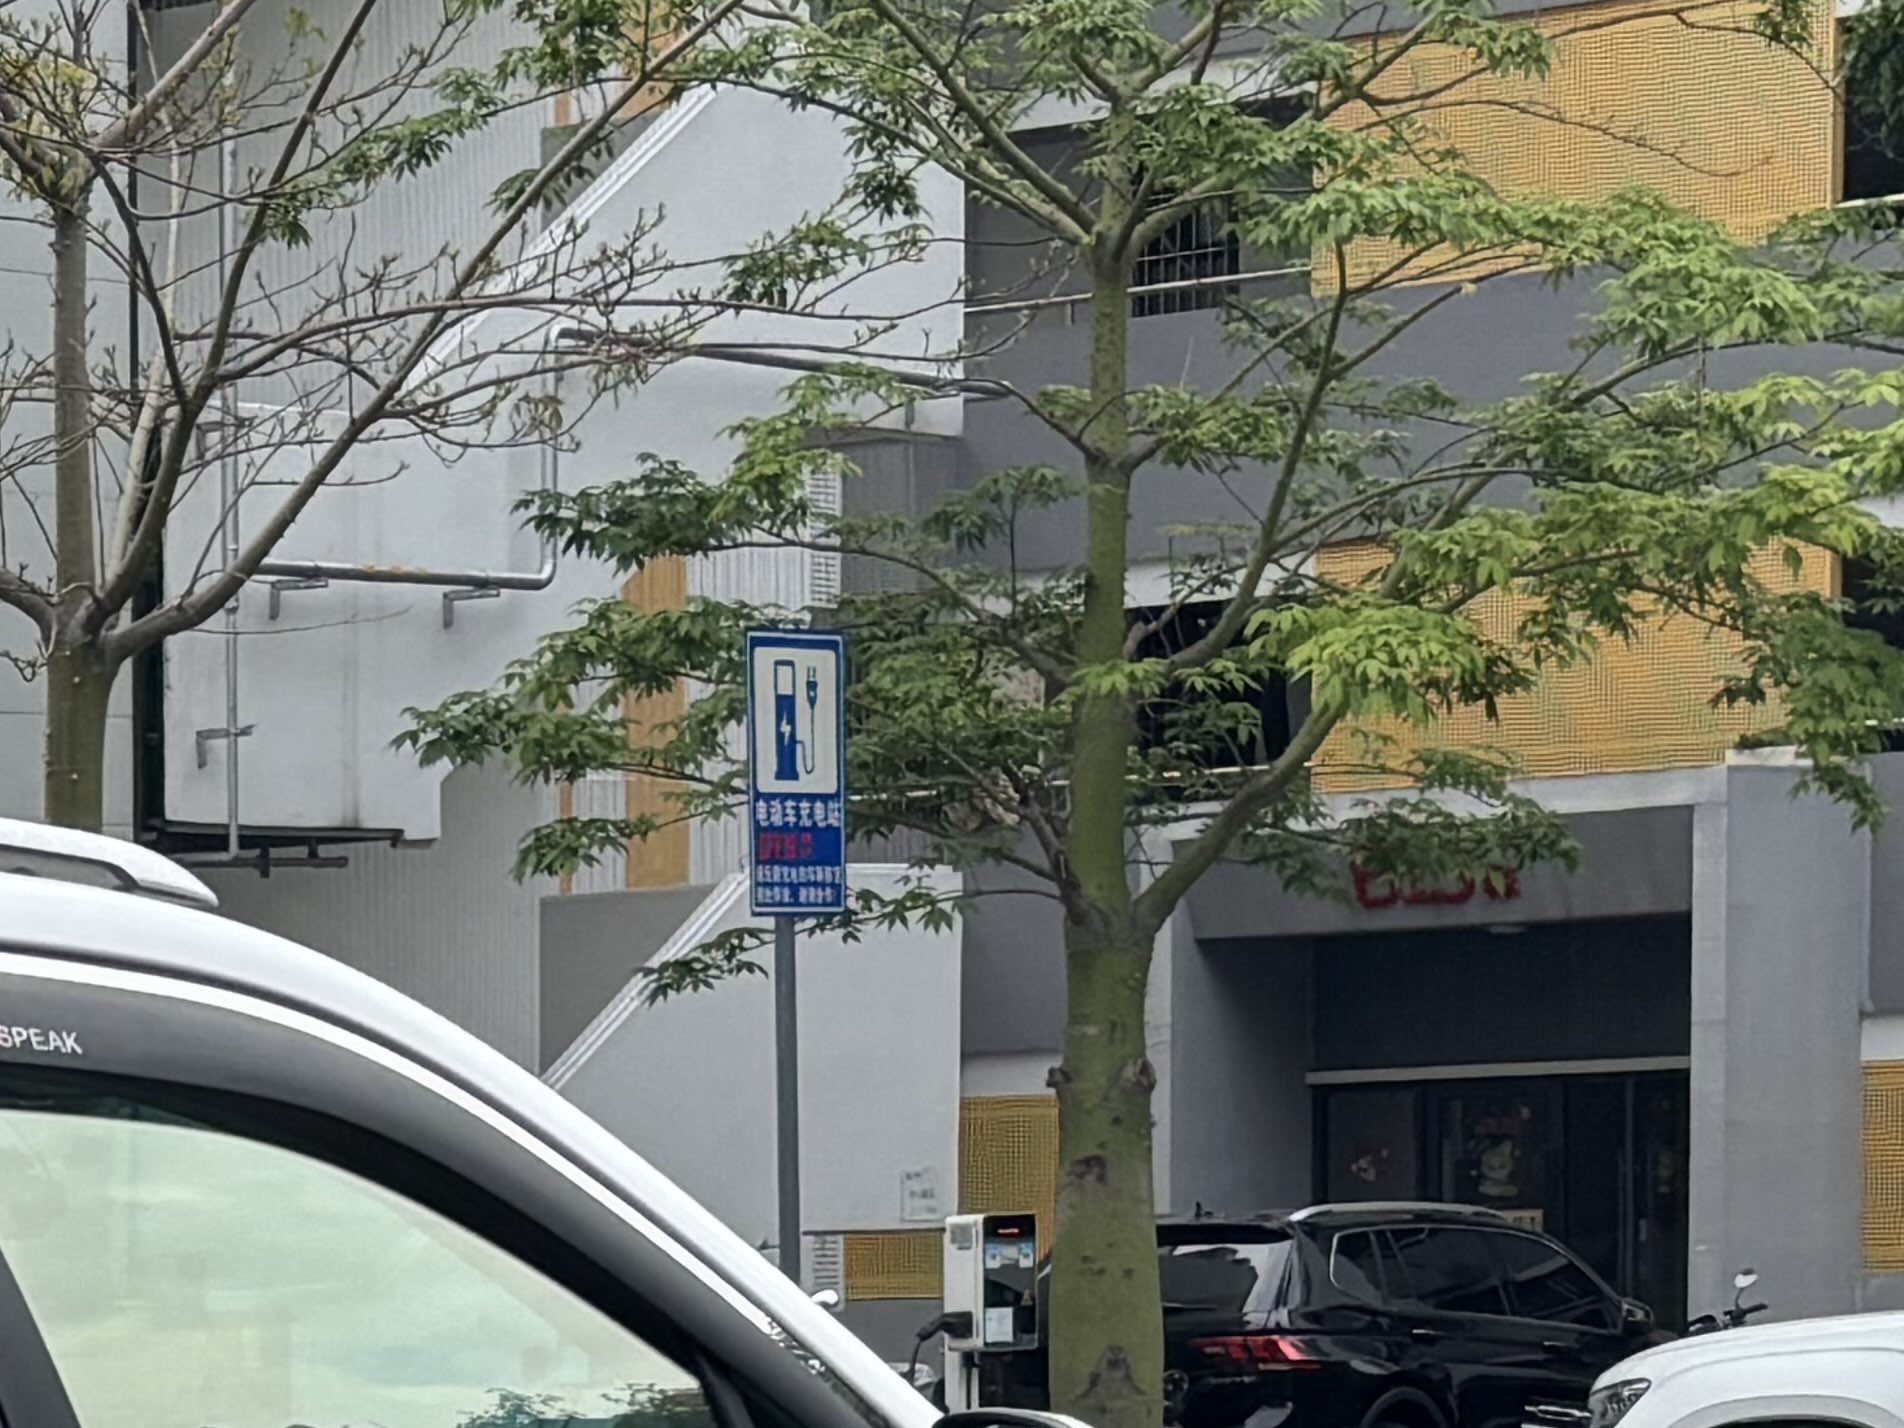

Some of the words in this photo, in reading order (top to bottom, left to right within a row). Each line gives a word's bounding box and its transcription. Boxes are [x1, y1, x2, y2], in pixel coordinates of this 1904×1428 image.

[755, 798, 841, 828] 电动车充电站
